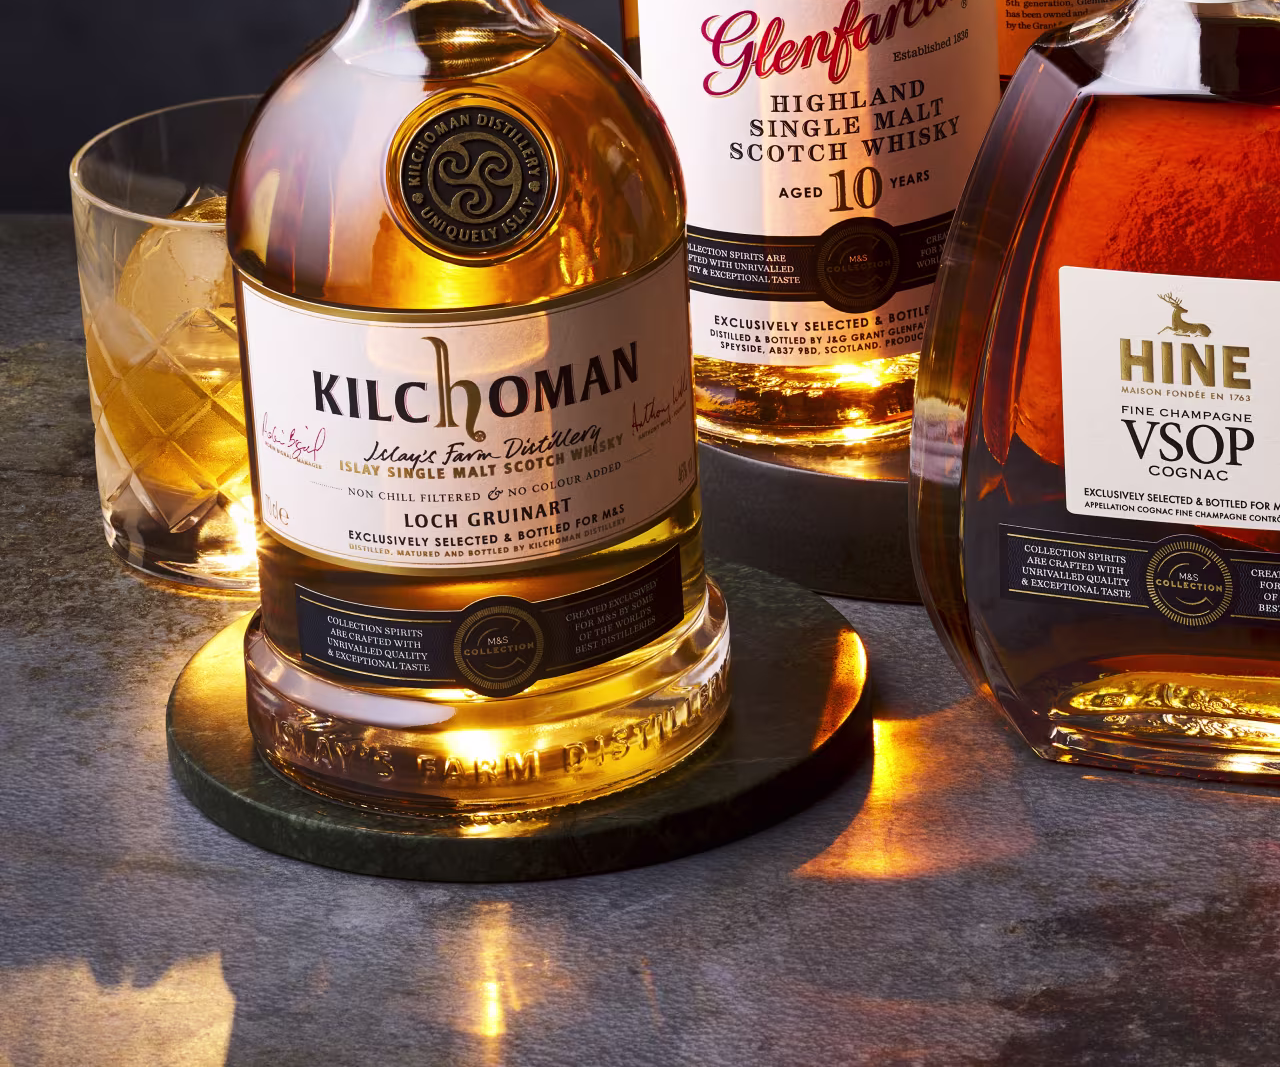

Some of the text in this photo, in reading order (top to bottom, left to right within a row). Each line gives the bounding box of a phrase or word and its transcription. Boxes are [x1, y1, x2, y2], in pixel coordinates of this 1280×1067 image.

[893, 29, 969, 62] Established 1836
[770, 79, 925, 113] HIGHLAND
[749, 98, 944, 138] SINGLE MALT
[409, 113, 541, 186] KILCHOMAN DISTILLERY
[730, 116, 960, 162] SCOTCH WHISKY
[779, 166, 930, 212] AGED 10 YEARS
[421, 197, 535, 242] UNIQUELY ISLAY
[710, 329, 750, 343] DISTILLED
[765, 335, 806, 344] BOTTLED
[810, 336, 822, 344] BY
[827, 333, 847, 343] J&G
[851, 330, 885, 342] GRANT
[715, 315, 882, 331] EXCLUSIVELY SELECTED &
[720, 342, 881, 355] SPEYSIDE, AB37 9BD, SCOTLAND.
[1120, 338, 1251, 389] HINE
[1121, 386, 1162, 396] MAISON
[1166, 389, 1206, 399] FONDÉE
[1121, 406, 1252, 423] FINE CHAMPAGNE
[340, 433, 624, 479] ISLAY SINGLE MALT SCOTCH WHISKY
[364, 425, 601, 470] Islay's Farm Distillery
[1121, 419, 1255, 466] VSOP
[348, 461, 621, 503] NON CHILL FILTERED & NO COLOUR ADDED
[1149, 465, 1228, 481] COGNAC
[404, 498, 572, 528] LOCH GRUINART
[1084, 488, 1144, 501] EXCLUSIVELY
[1147, 493, 1193, 505] SELECTED
[1196, 497, 1203, 506] &
[1206, 498, 1248, 509] BOTTLED
[1250, 501, 1270, 510] FOR
[1084, 501, 1135, 512] APPELLATION
[1137, 506, 1174, 516] COGNAC
[1176, 509, 1193, 517] FINE
[1195, 511, 1247, 521] CHAMPAGNE
[349, 504, 625, 547] EXCLUSIVELY SELECTED & BOTTLED FOR M&S
[1156, 579, 1223, 592] COLLECTION
[1179, 572, 1199, 581] M&S
